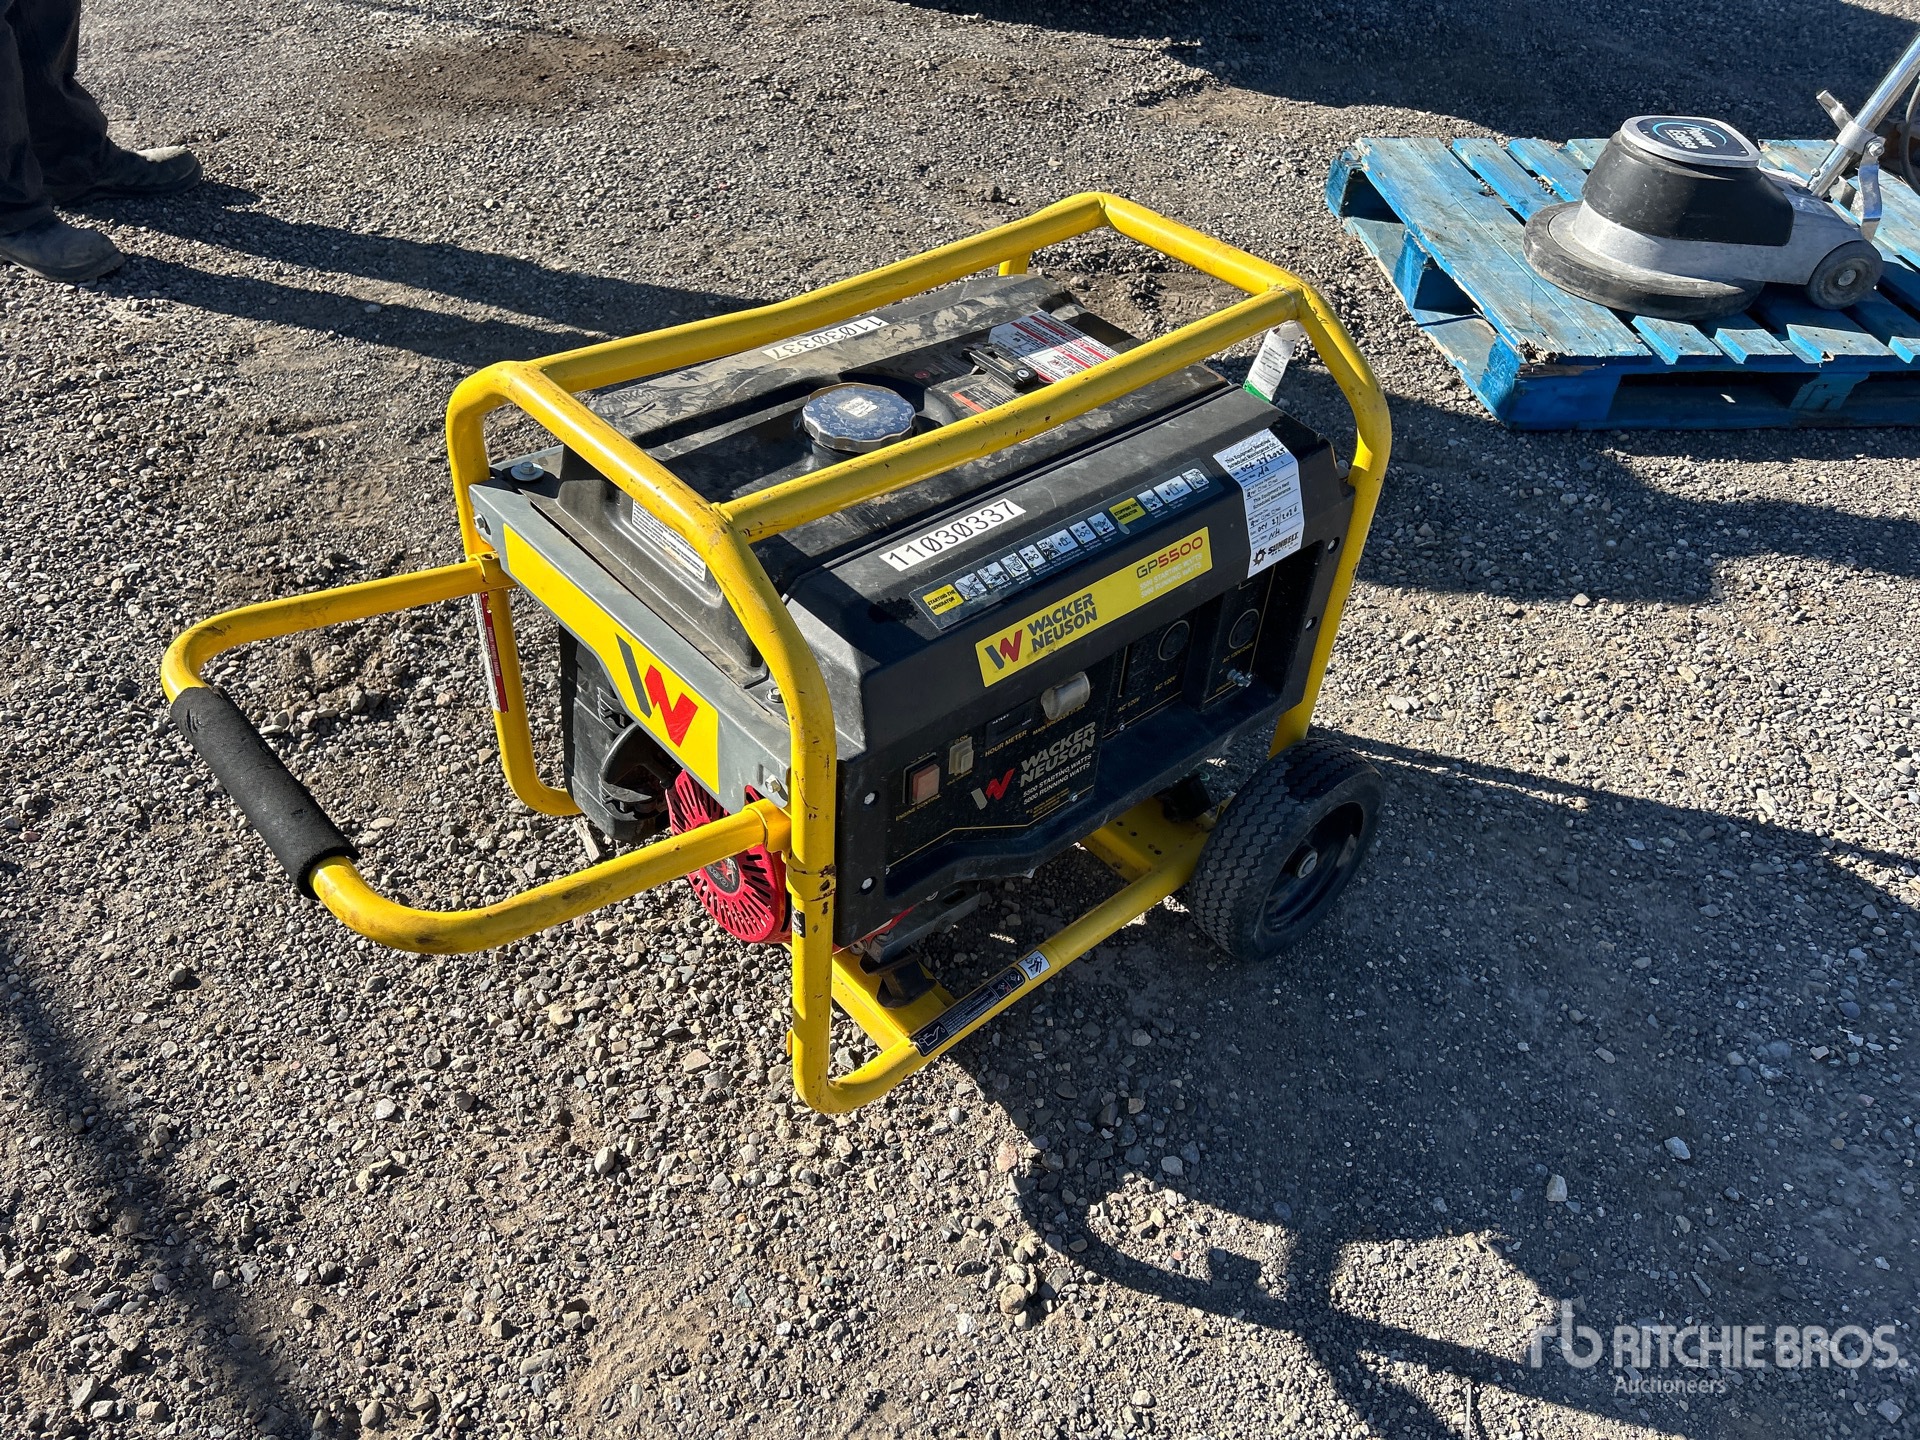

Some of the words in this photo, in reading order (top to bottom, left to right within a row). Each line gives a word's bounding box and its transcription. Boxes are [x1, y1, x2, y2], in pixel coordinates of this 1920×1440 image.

[772, 318, 883, 360] 11030337
[889, 500, 1016, 567] 11030337
[1136, 536, 1203, 579] GP5500
[1026, 593, 1095, 637] WACKER
[1031, 606, 1098, 653] NEUSON
[1004, 729, 1028, 746] METER
[1020, 721, 1096, 773] WACKER
[1020, 732, 1096, 788] NEUSON
[1039, 766, 1070, 789] STARTING
[1070, 753, 1093, 769] WATTS
[1039, 774, 1069, 796] RUNNING
[1069, 761, 1092, 778] WATTS
